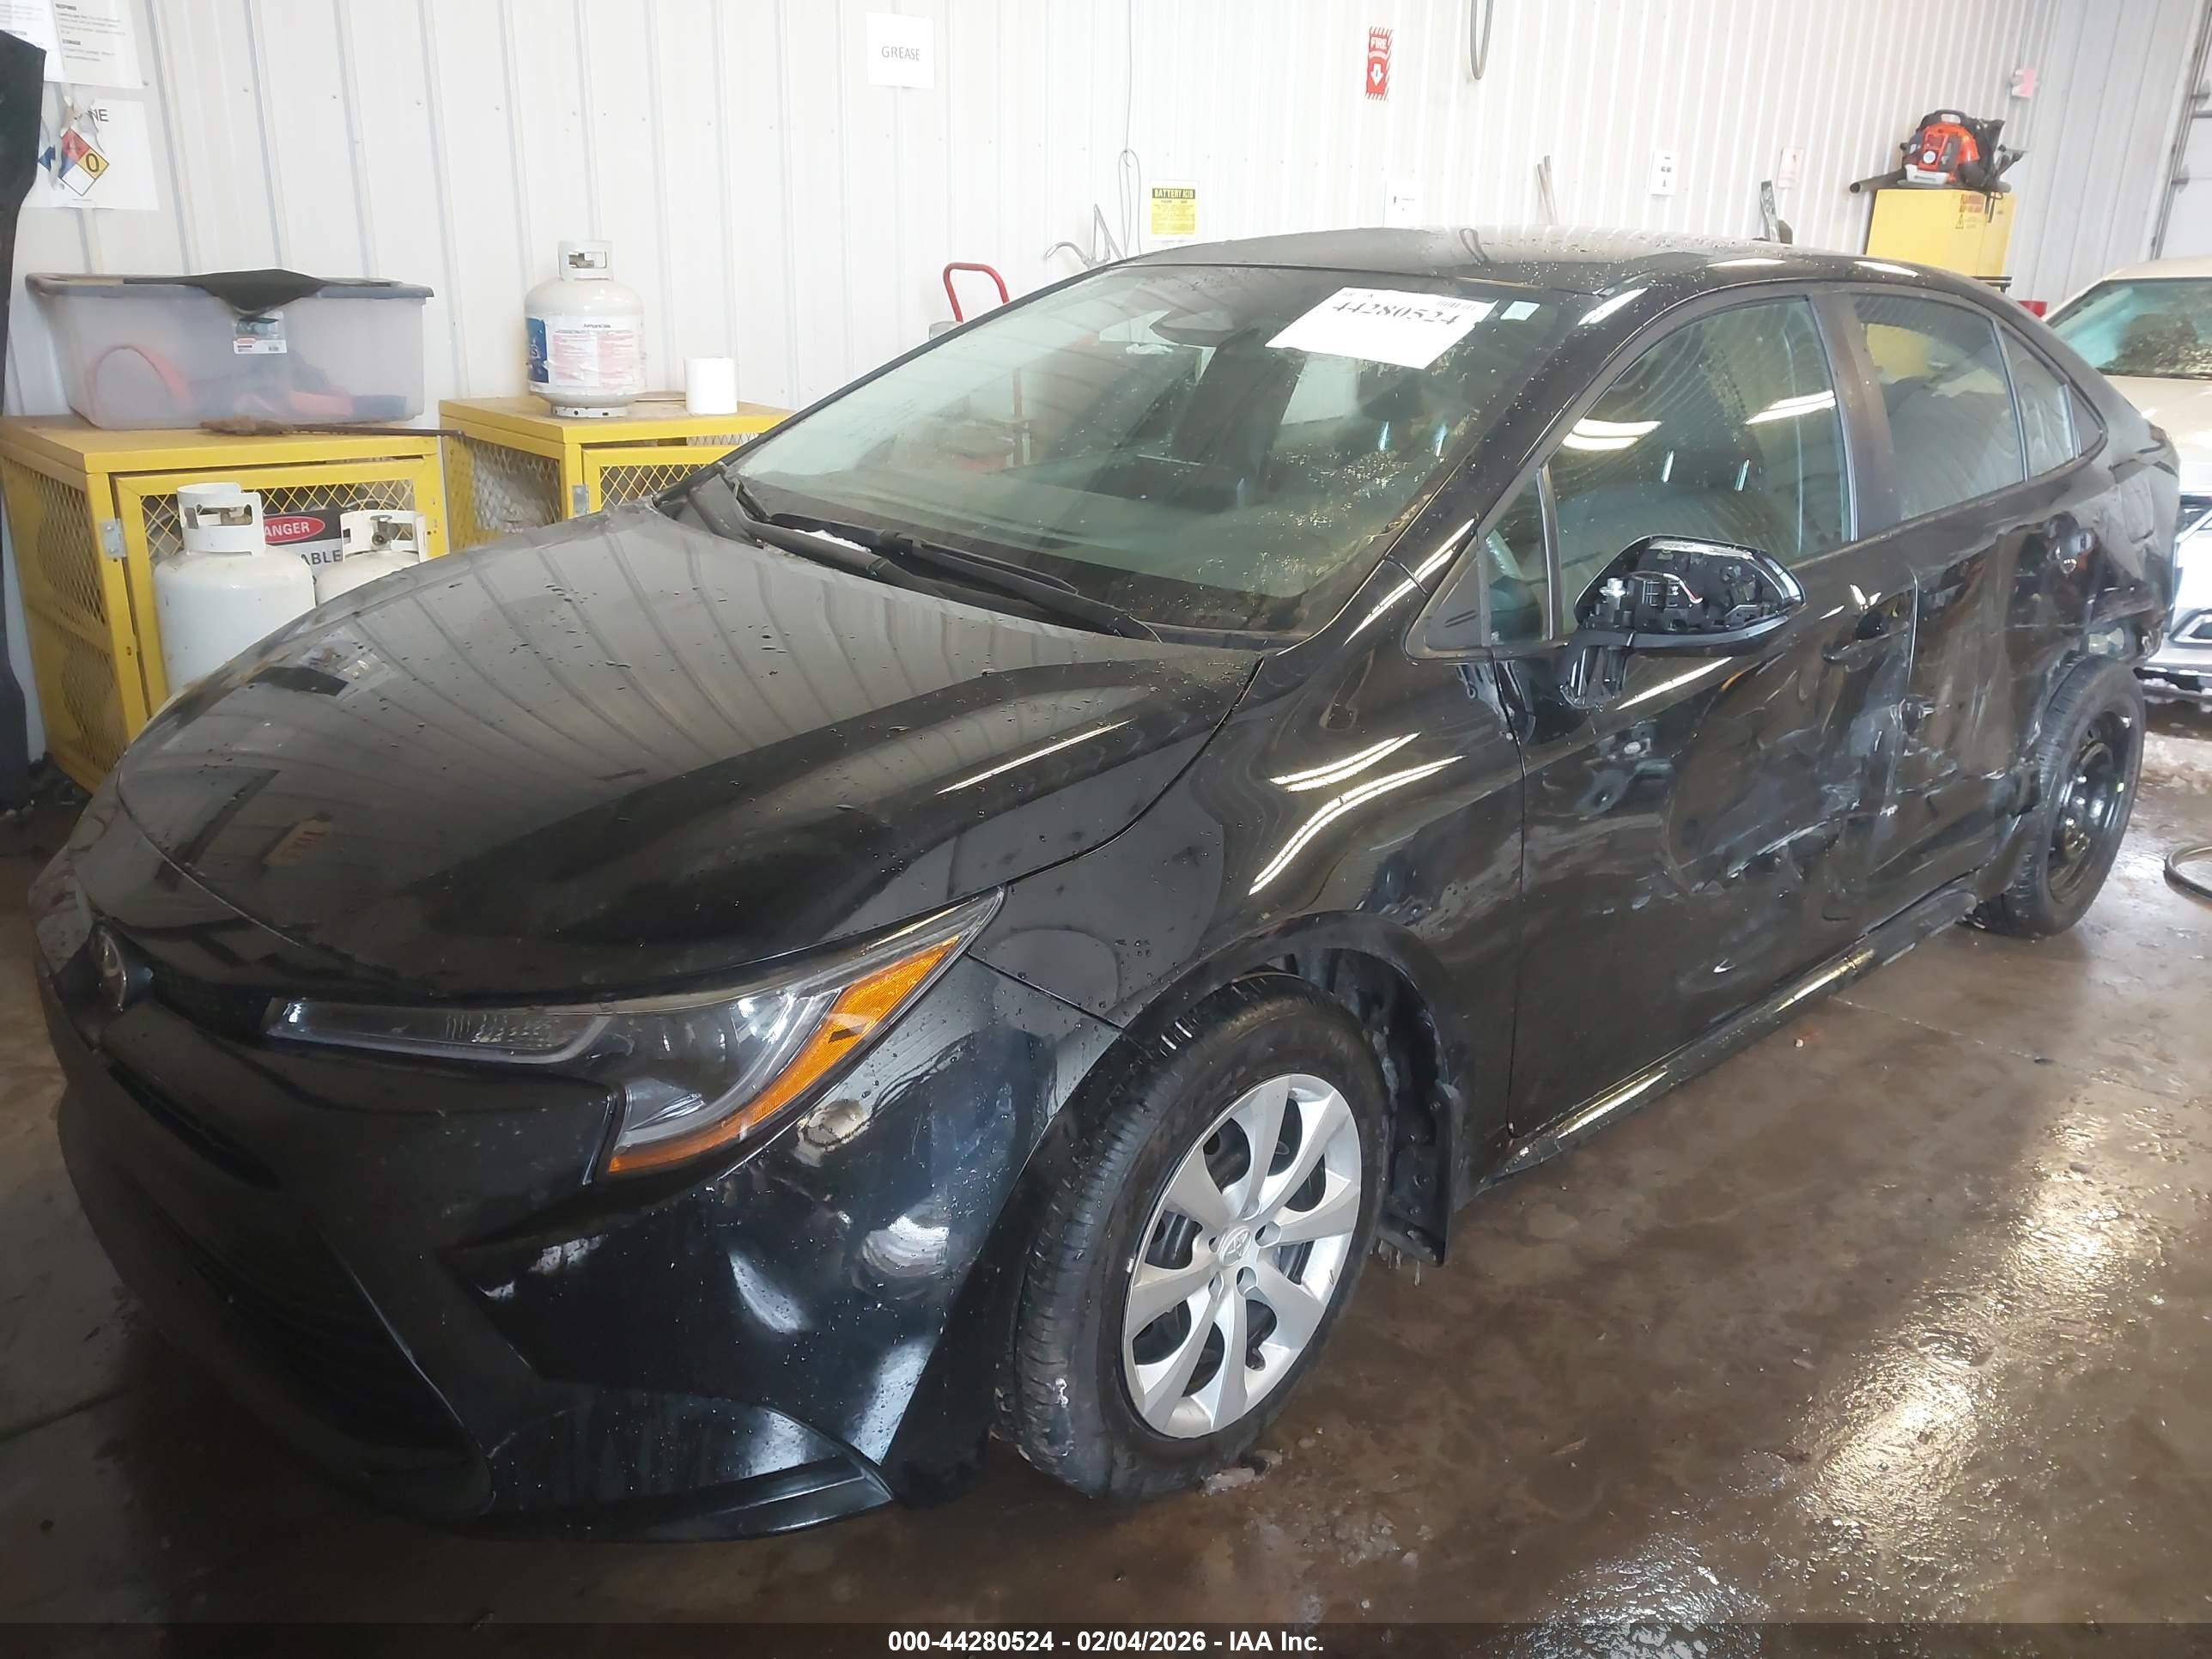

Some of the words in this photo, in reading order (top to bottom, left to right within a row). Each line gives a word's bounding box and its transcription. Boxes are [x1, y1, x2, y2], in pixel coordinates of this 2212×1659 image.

[1370, 36, 1387, 50] FIRE
[881, 46, 921, 61] GREASE
[1154, 188, 1182, 198] BATTERY
[1332, 301, 1461, 325] 44280524
[264, 521, 310, 538] ANGER
[301, 549, 342, 566] ABLE
